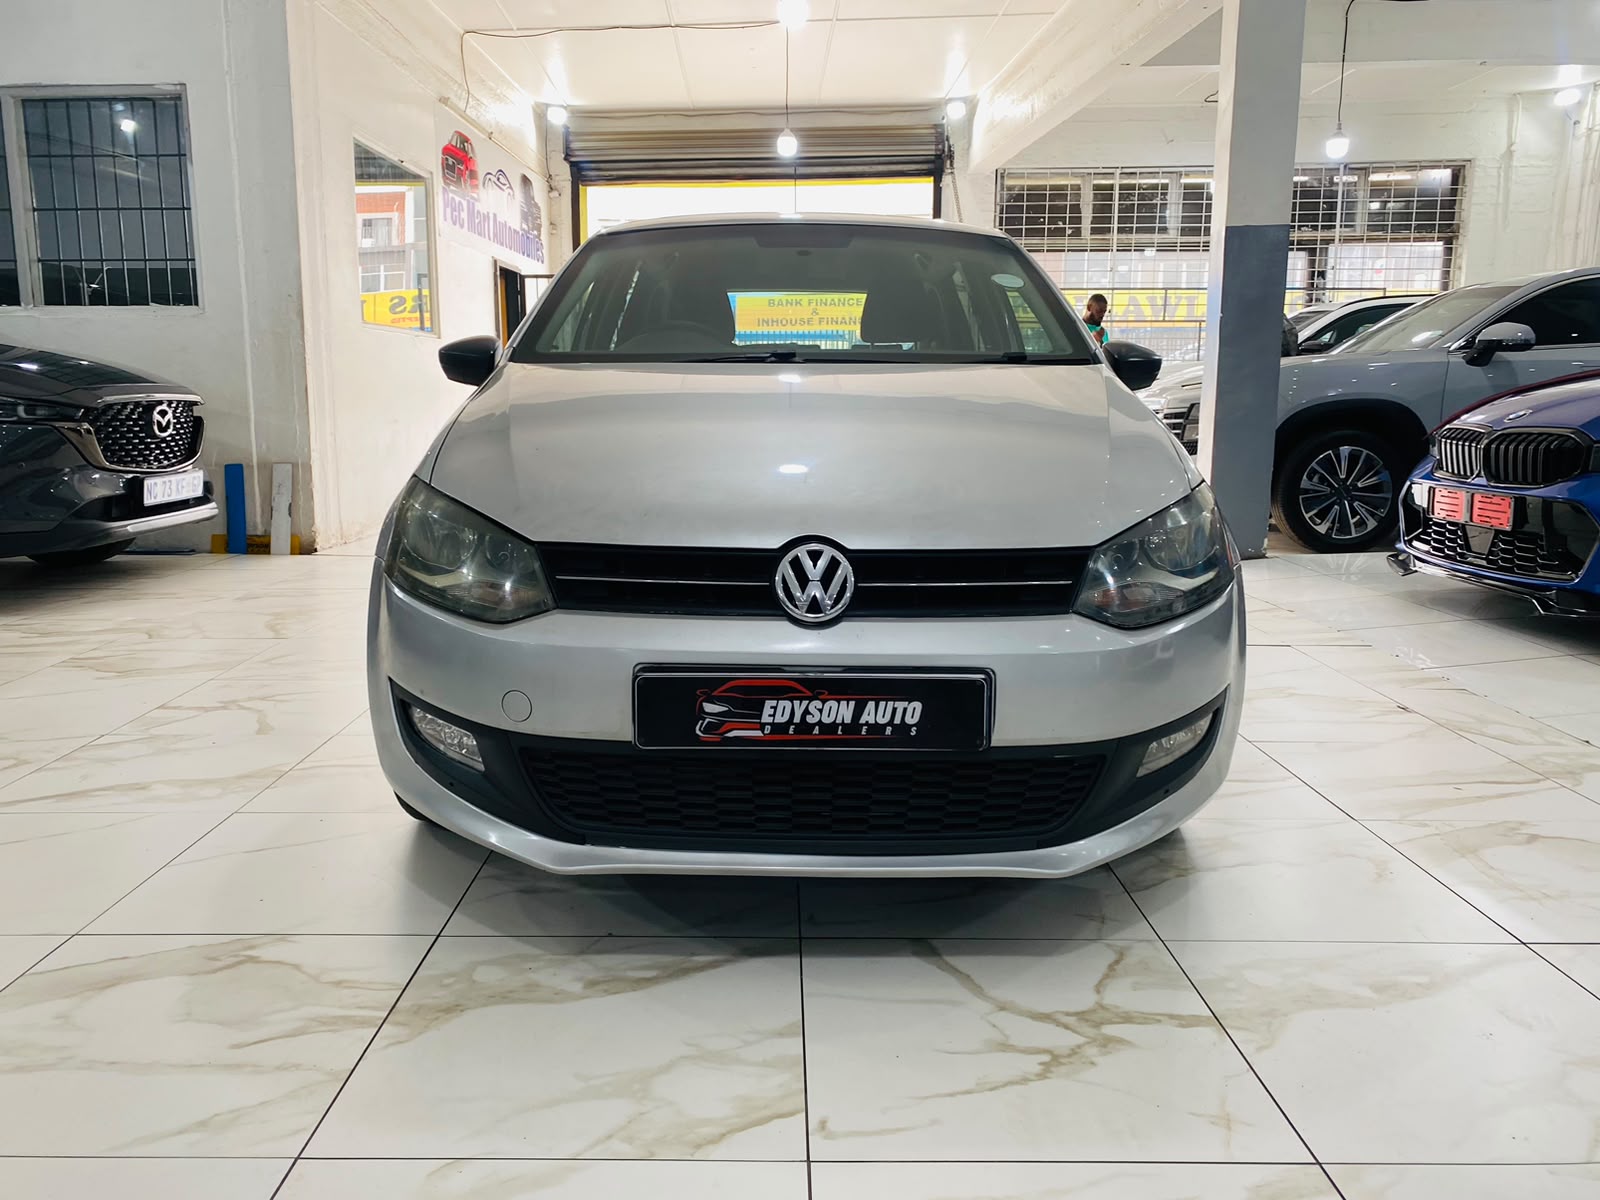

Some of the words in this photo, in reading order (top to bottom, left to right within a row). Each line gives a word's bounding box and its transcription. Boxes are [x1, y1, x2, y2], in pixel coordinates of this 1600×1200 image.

[442, 188, 465, 229] Pec
[467, 198, 491, 241] Mart
[493, 212, 545, 265] Automobiles
[768, 299, 803, 308] BANK
[808, 297, 863, 307] FINANCE
[811, 308, 820, 316] &
[757, 317, 814, 328] INHOUSE
[146, 482, 159, 501] NC
[161, 480, 173, 498] 73
[176, 478, 186, 496] KF
[761, 700, 855, 724] EDYSON
[859, 701, 923, 725] AUTO
[764, 726, 917, 735] DEALERS
